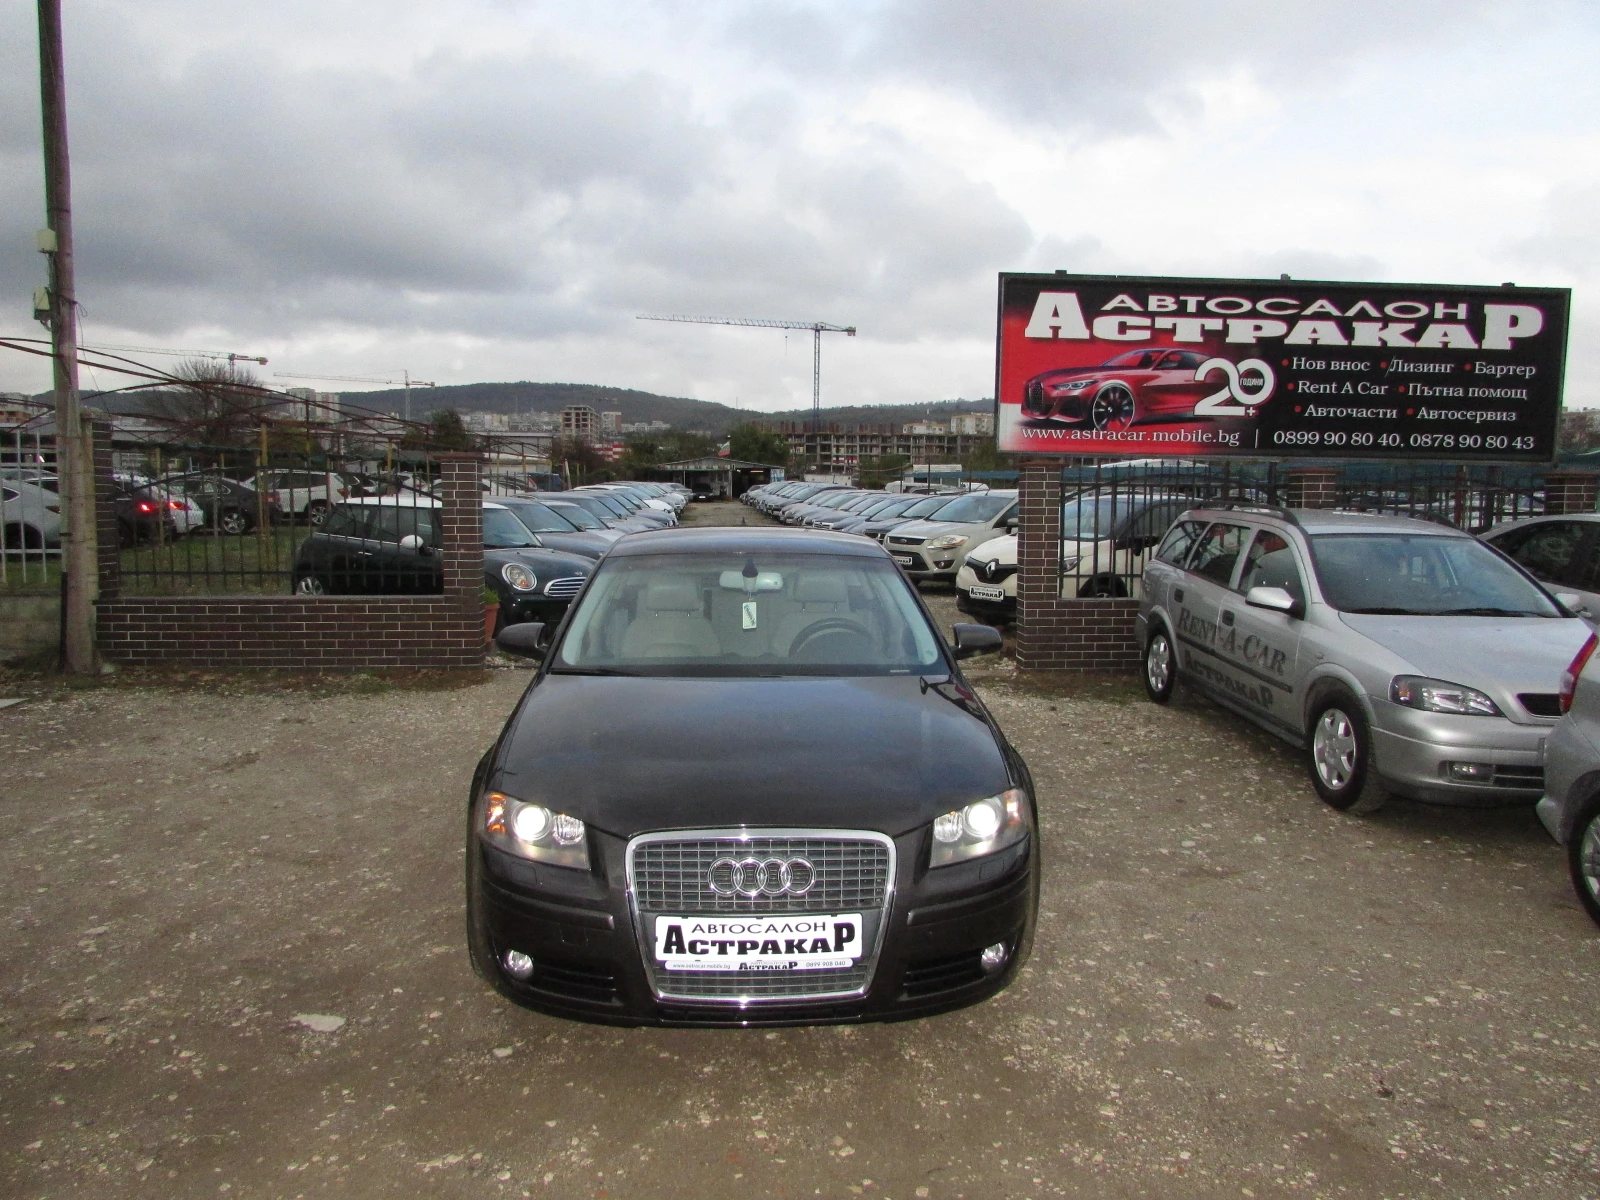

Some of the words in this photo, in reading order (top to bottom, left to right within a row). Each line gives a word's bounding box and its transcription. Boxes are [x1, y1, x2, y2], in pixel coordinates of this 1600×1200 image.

[1100, 294, 1468, 320] АВТОСАЛОН
[1292, 356, 1326, 370] Нов
[1330, 360, 1370, 371] внос
[1474, 361, 1536, 379] Бартер
[1297, 380, 1337, 394] Rent
[1340, 381, 1354, 394] A
[1357, 382, 1389, 395] Car
[1407, 383, 1464, 397] Пътна
[1468, 387, 1528, 400] помощ
[1304, 404, 1398, 418] Авточасти
[1416, 407, 1517, 423] Автосервиз
[1021, 427, 1240, 446] www.astracar.mobile.bg
[1273, 430, 1320, 445] 0899
[1323, 431, 1346, 446] 90
[1350, 432, 1373, 446] 80
[1409, 433, 1454, 447] 0878
[1458, 434, 1481, 448] 90
[1485, 435, 1508, 449] 80
[1511, 436, 1535, 450] 43
[691, 922, 827, 934] АВТОСАЛОН
